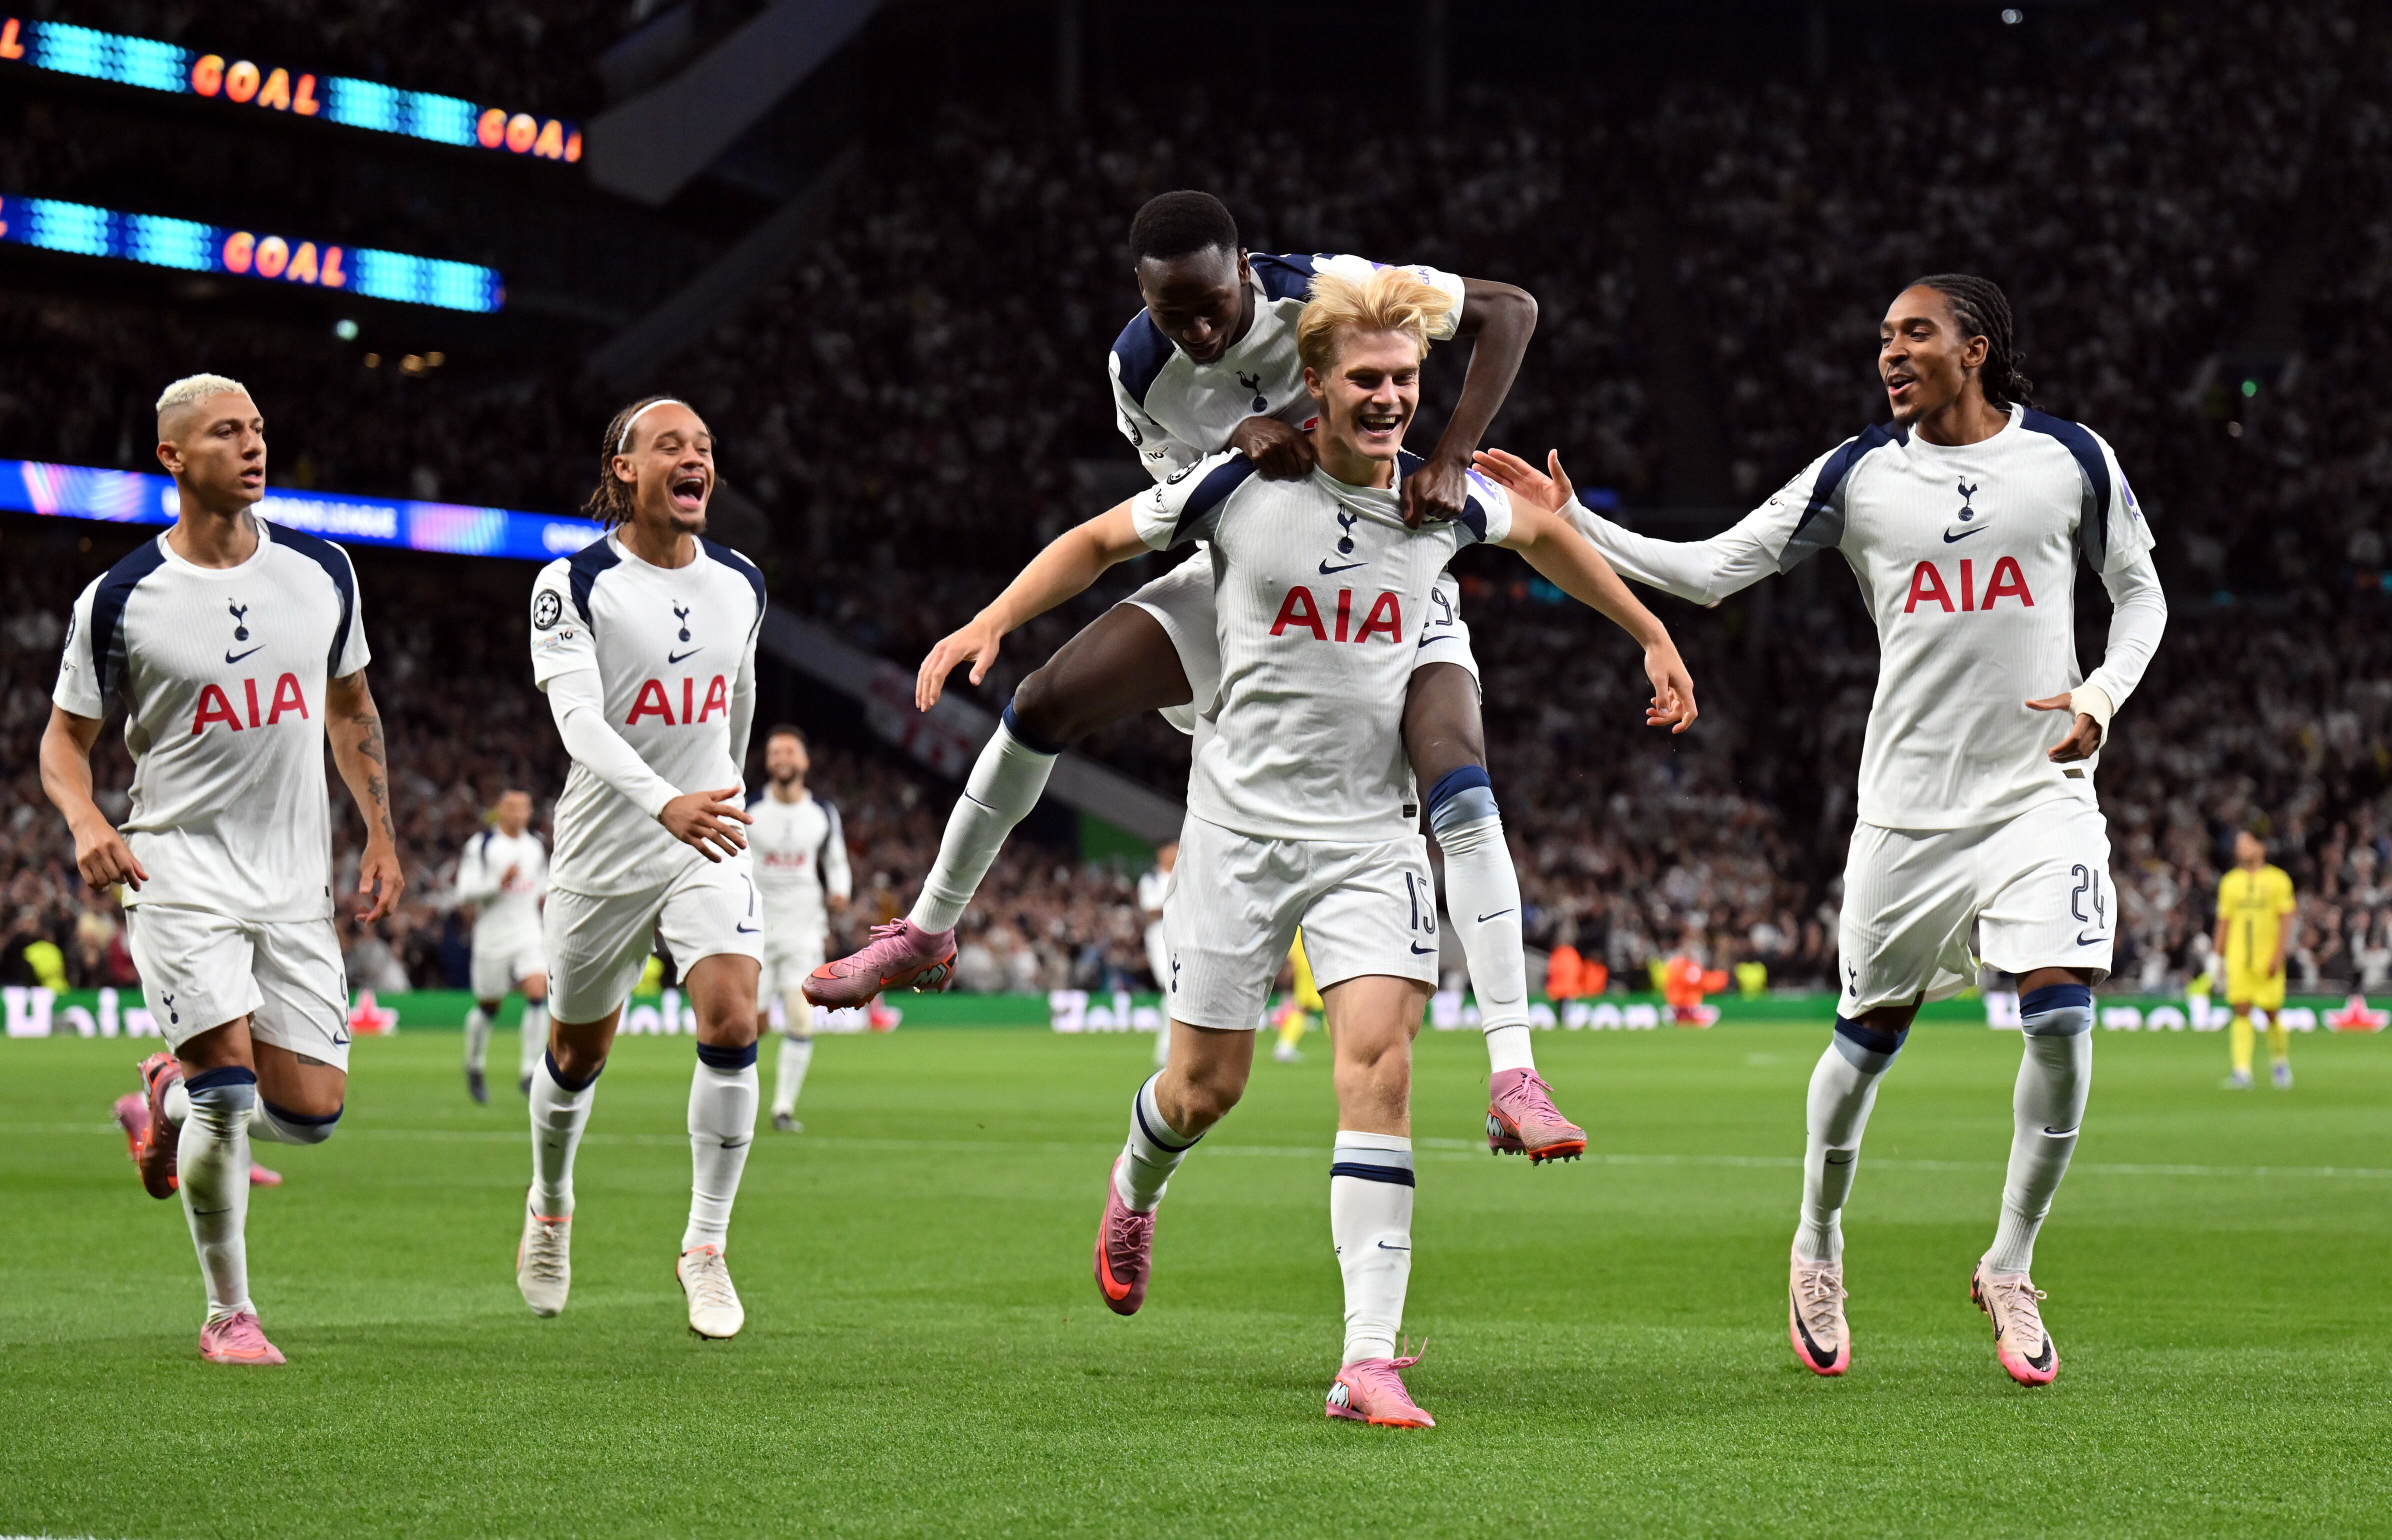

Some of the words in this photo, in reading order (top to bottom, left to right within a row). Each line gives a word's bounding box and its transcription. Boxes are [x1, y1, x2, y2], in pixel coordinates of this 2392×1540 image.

[192, 54, 320, 116] GOAL
[222, 231, 347, 288] GOAL
[1424, 586, 1453, 628] 9
[1904, 556, 2034, 613] AIA
[1269, 586, 1402, 644] AIA
[192, 672, 310, 735] AIA
[625, 674, 728, 726] AIA
[1406, 872, 1436, 934] 15
[2072, 864, 2105, 929] 24
